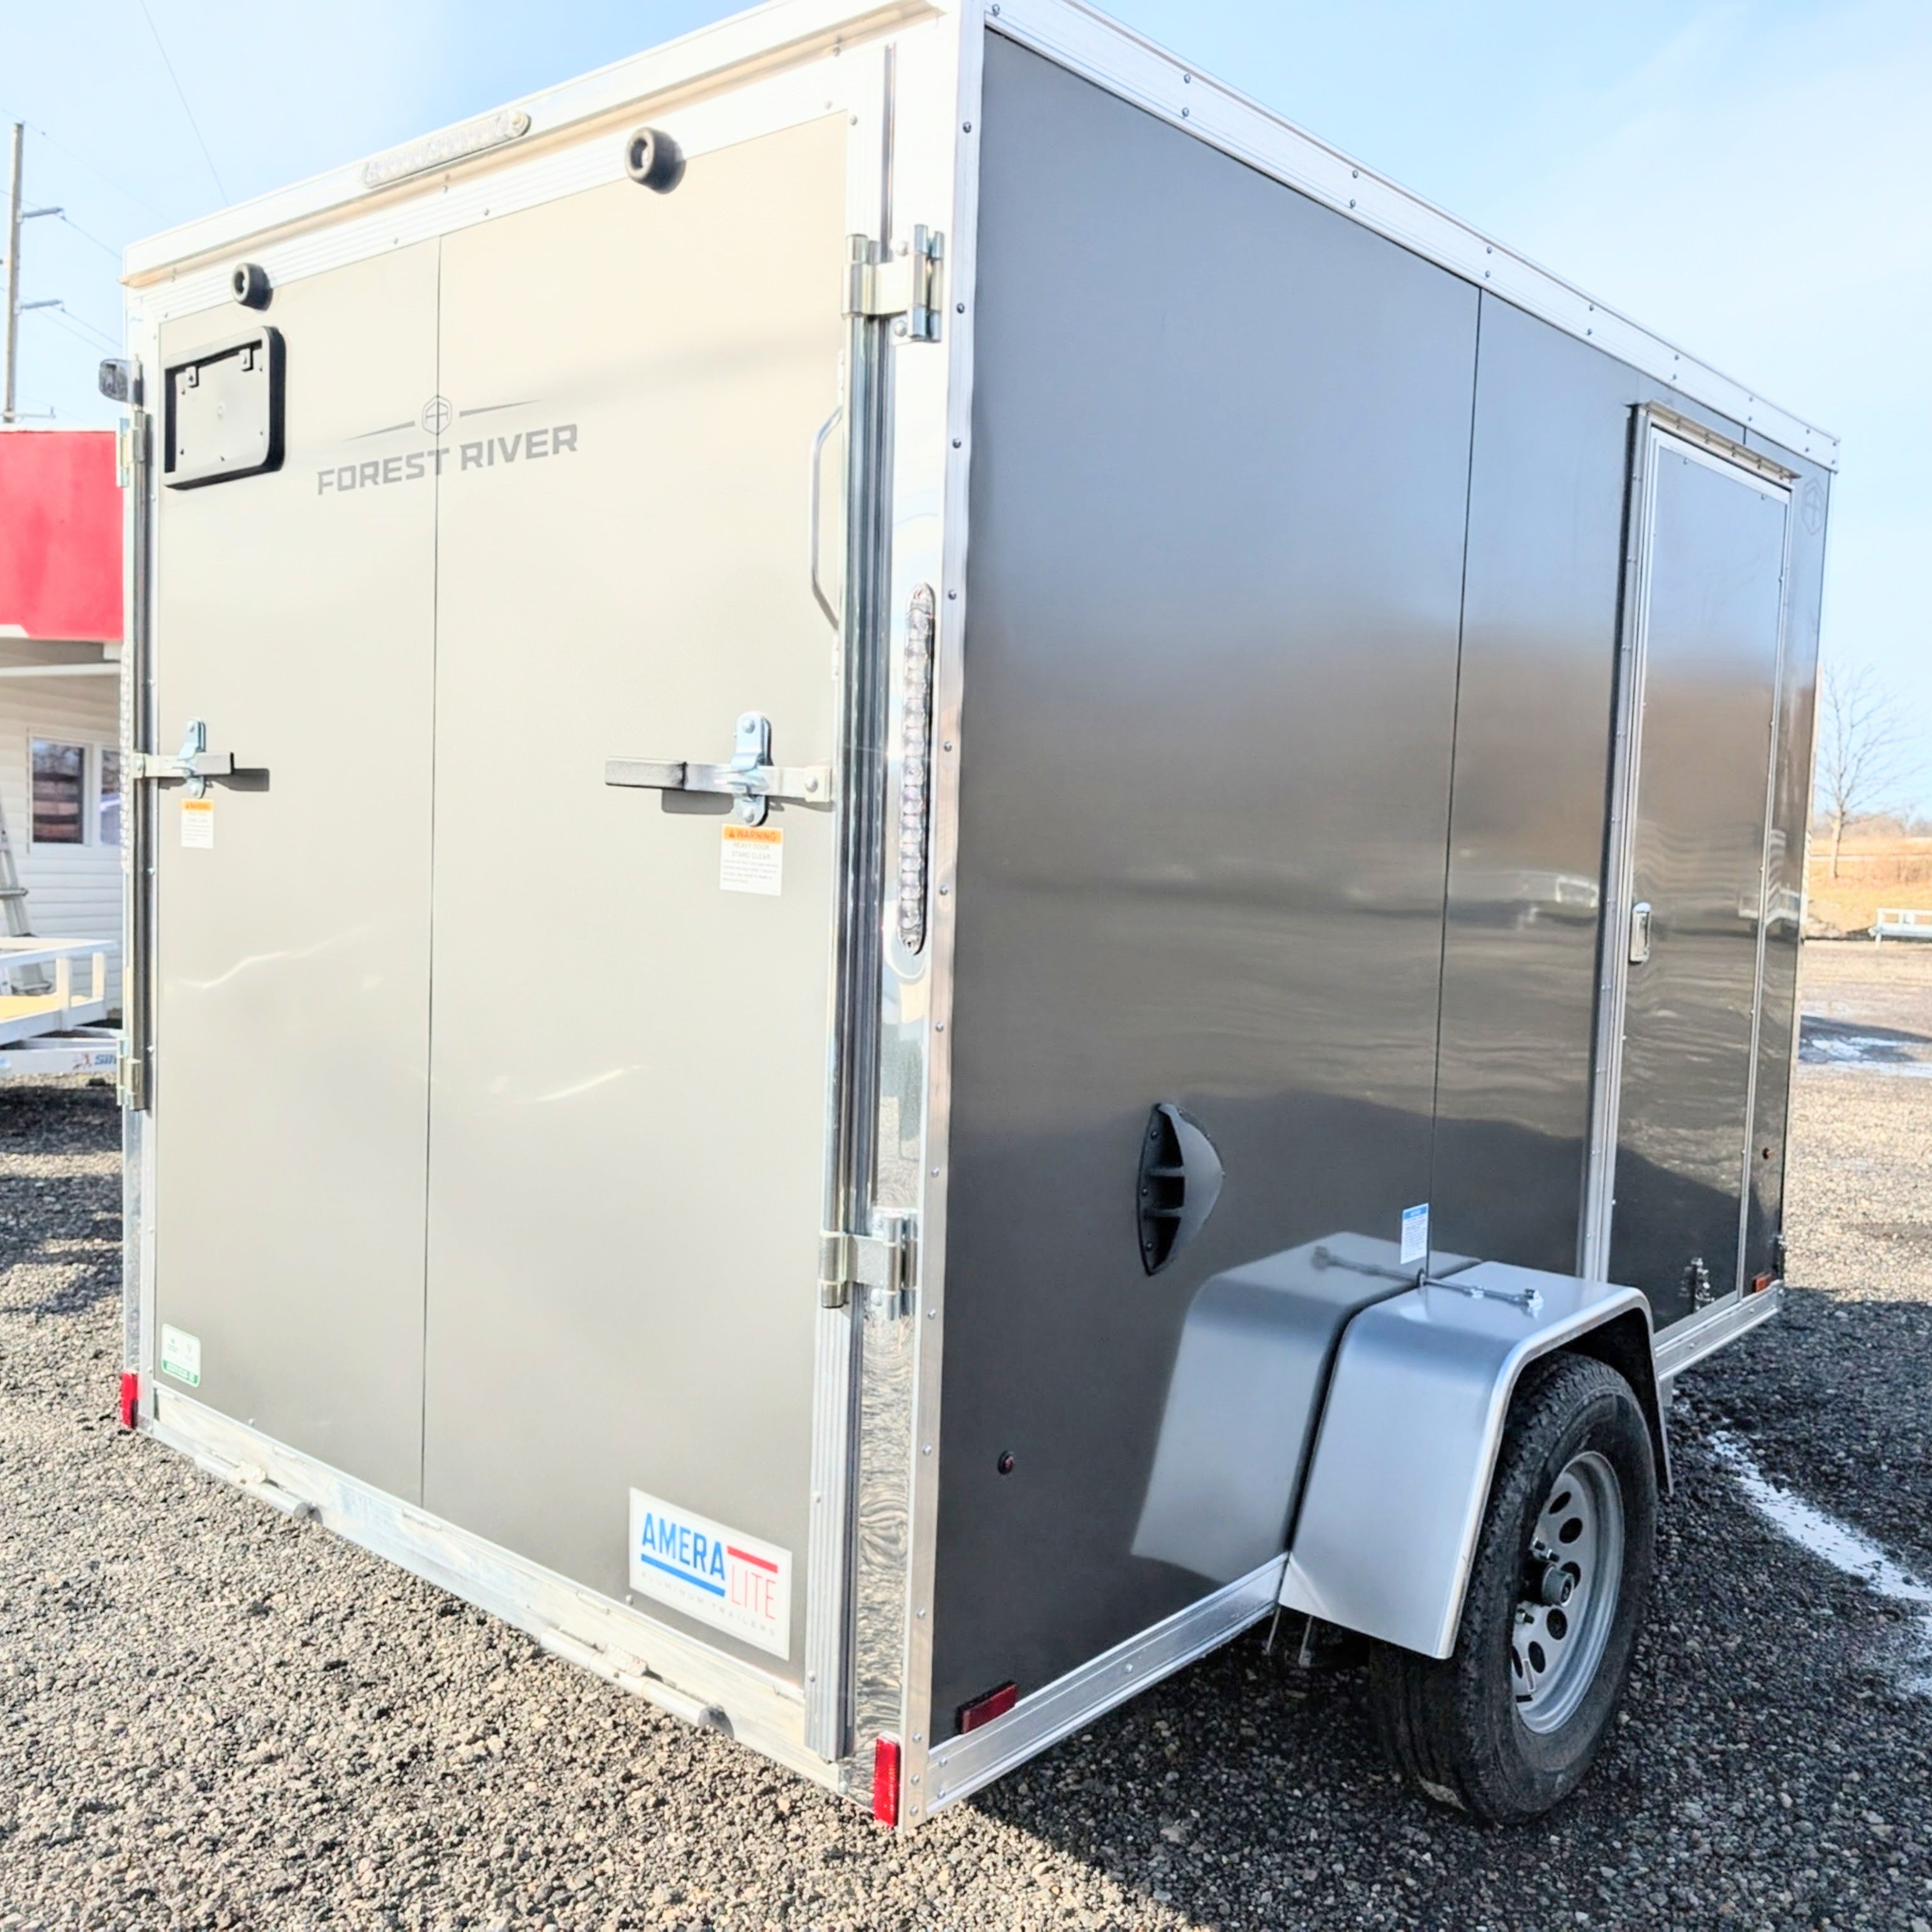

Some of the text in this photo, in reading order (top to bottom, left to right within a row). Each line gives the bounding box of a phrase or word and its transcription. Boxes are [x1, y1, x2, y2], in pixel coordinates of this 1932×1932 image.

[317, 423, 578, 496] FOREST RIVER
[737, 830, 776, 841] WARNING
[641, 1512, 777, 1620] AMERA LITE
[641, 1570, 776, 1636] ALUMINUM TRAILERS
